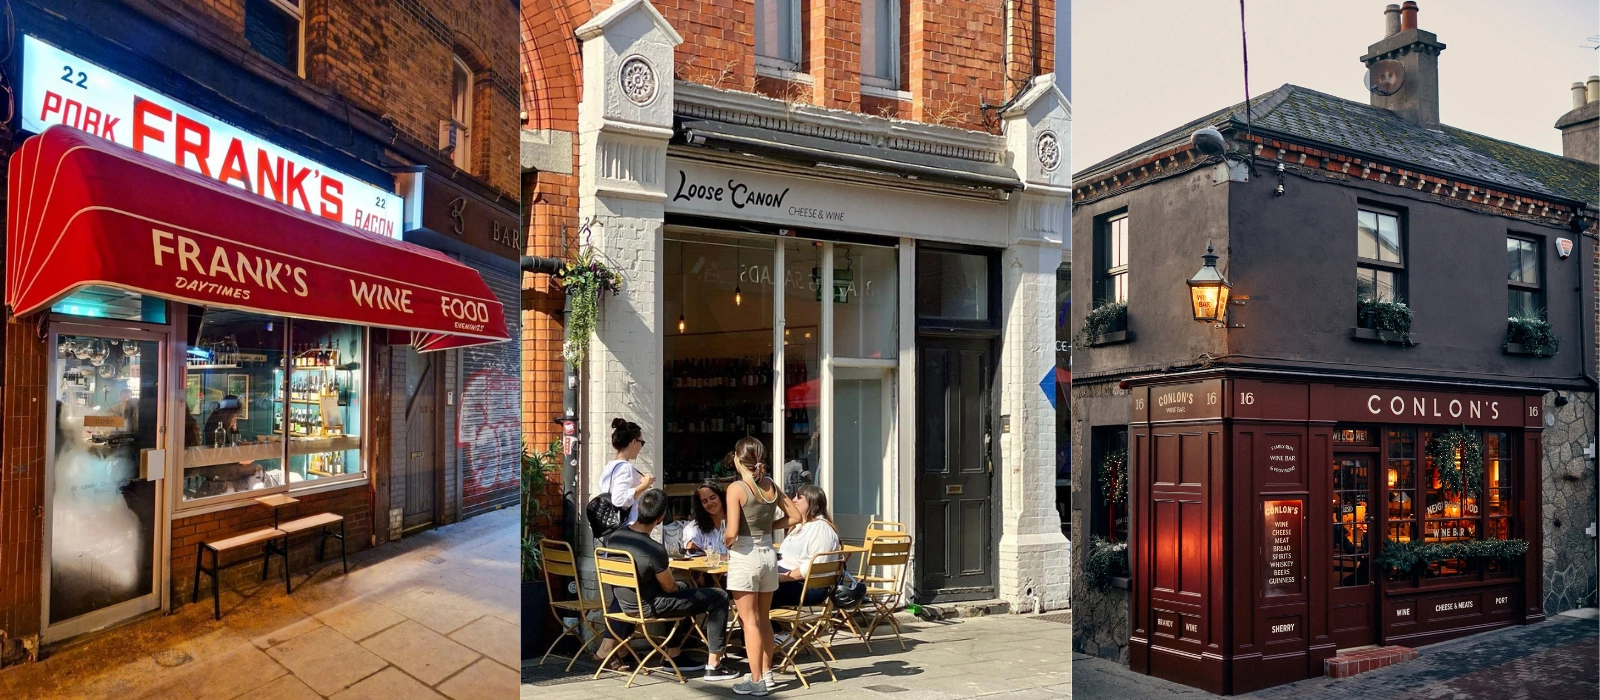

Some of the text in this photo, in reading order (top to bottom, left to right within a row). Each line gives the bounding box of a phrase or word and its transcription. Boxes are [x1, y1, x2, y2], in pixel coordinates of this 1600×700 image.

[61, 65, 88, 89] 22
[40, 90, 121, 142] PORK
[133, 94, 344, 223] FRANK'S
[375, 196, 386, 209] 22
[788, 206, 845, 221] CHEESE & WINE
[354, 208, 394, 237] BACON
[152, 228, 308, 297] FRANK'S
[175, 276, 251, 300] DAYTIMES
[350, 279, 414, 314] WINE
[441, 296, 489, 322] FOOD
[454, 321, 485, 332] EVENINGS
[1135, 398, 1145, 410] 16
[1158, 391, 1194, 406] CONLON'S
[1206, 392, 1217, 405] 16
[1240, 392, 1254, 405] 16
[1367, 394, 1499, 419] CONLON'S
[1529, 406, 1539, 417] 16
[1265, 505, 1299, 515] CONLON'S
[1396, 608, 1411, 617] WINE
[1435, 601, 1473, 612] CHEESE & MEATS
[1157, 618, 1174, 628] BRANDY
[1185, 623, 1198, 633] WINE
[1271, 623, 1295, 634] SHERRY
